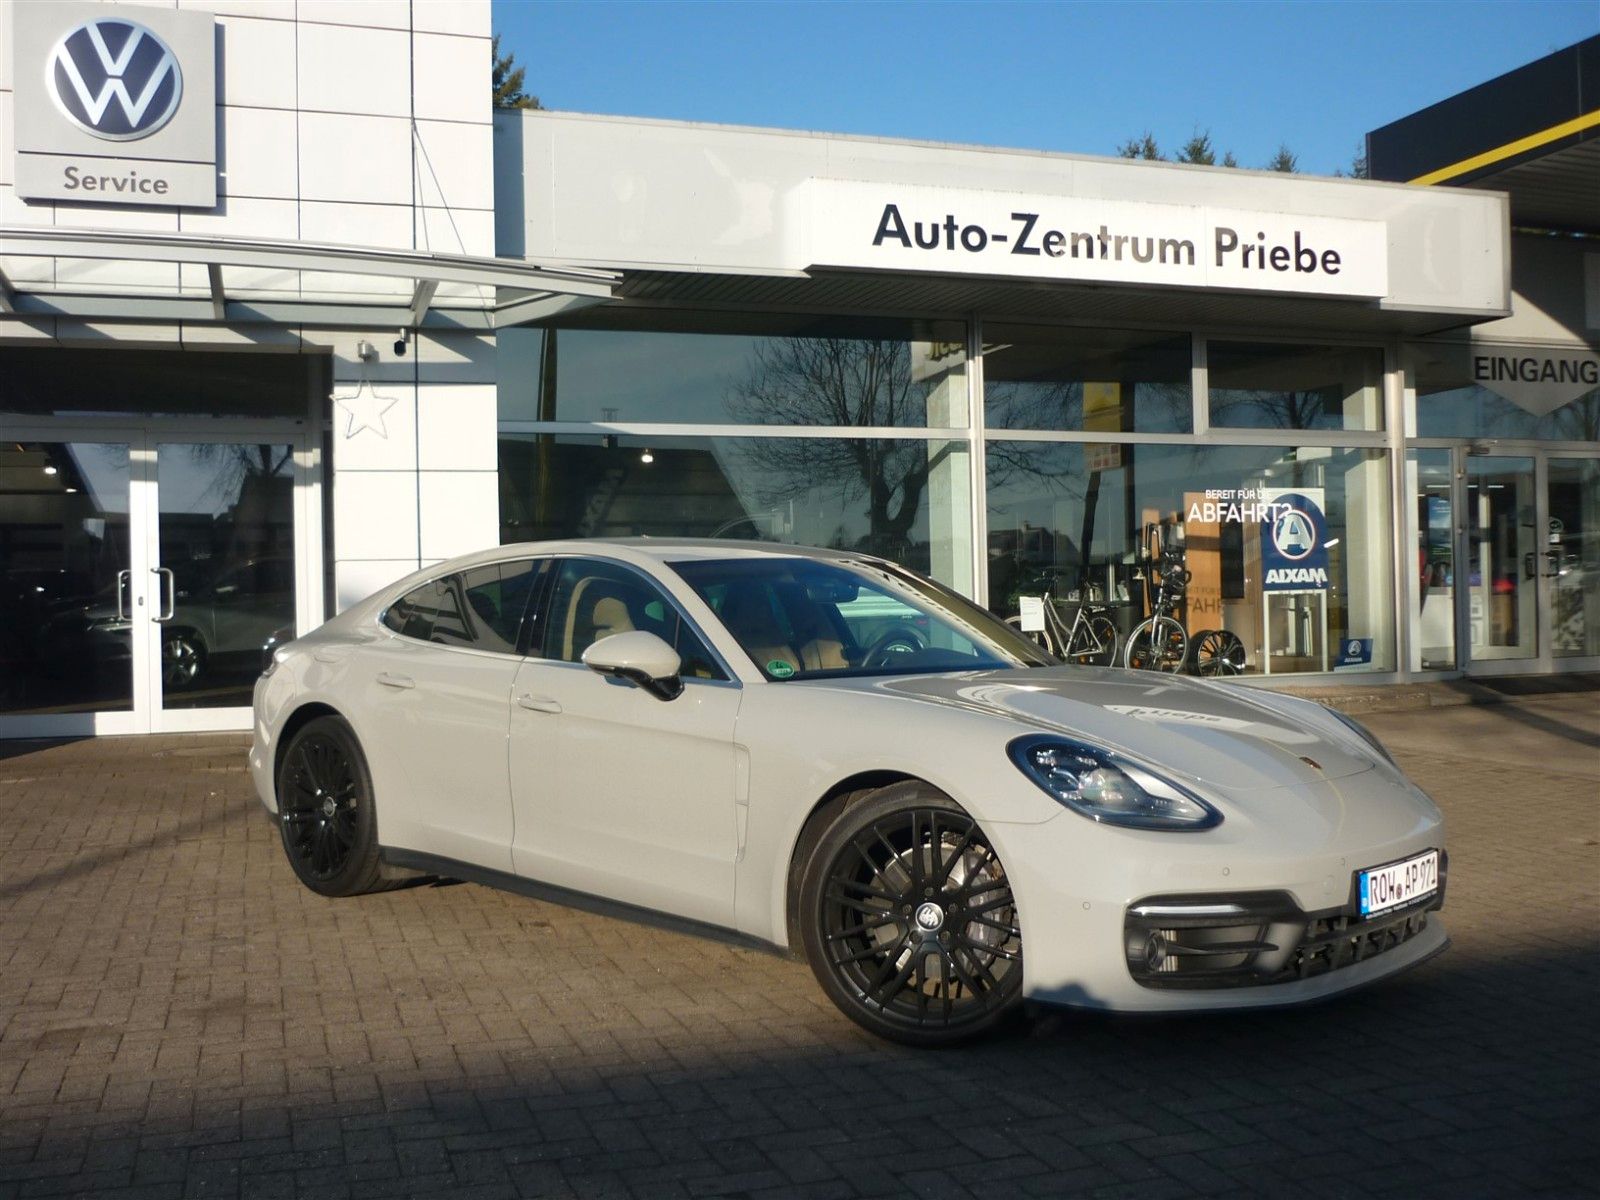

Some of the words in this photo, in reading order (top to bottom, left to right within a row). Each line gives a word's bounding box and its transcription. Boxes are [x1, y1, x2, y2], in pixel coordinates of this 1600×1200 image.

[64, 166, 169, 195] Service
[872, 203, 1195, 266] Auto-Zentrum
[1215, 227, 1341, 275] Priebe
[1474, 356, 1598, 384] EINGANG
[1205, 489, 1236, 500] BEREIT
[1265, 567, 1328, 584] AIXAM
